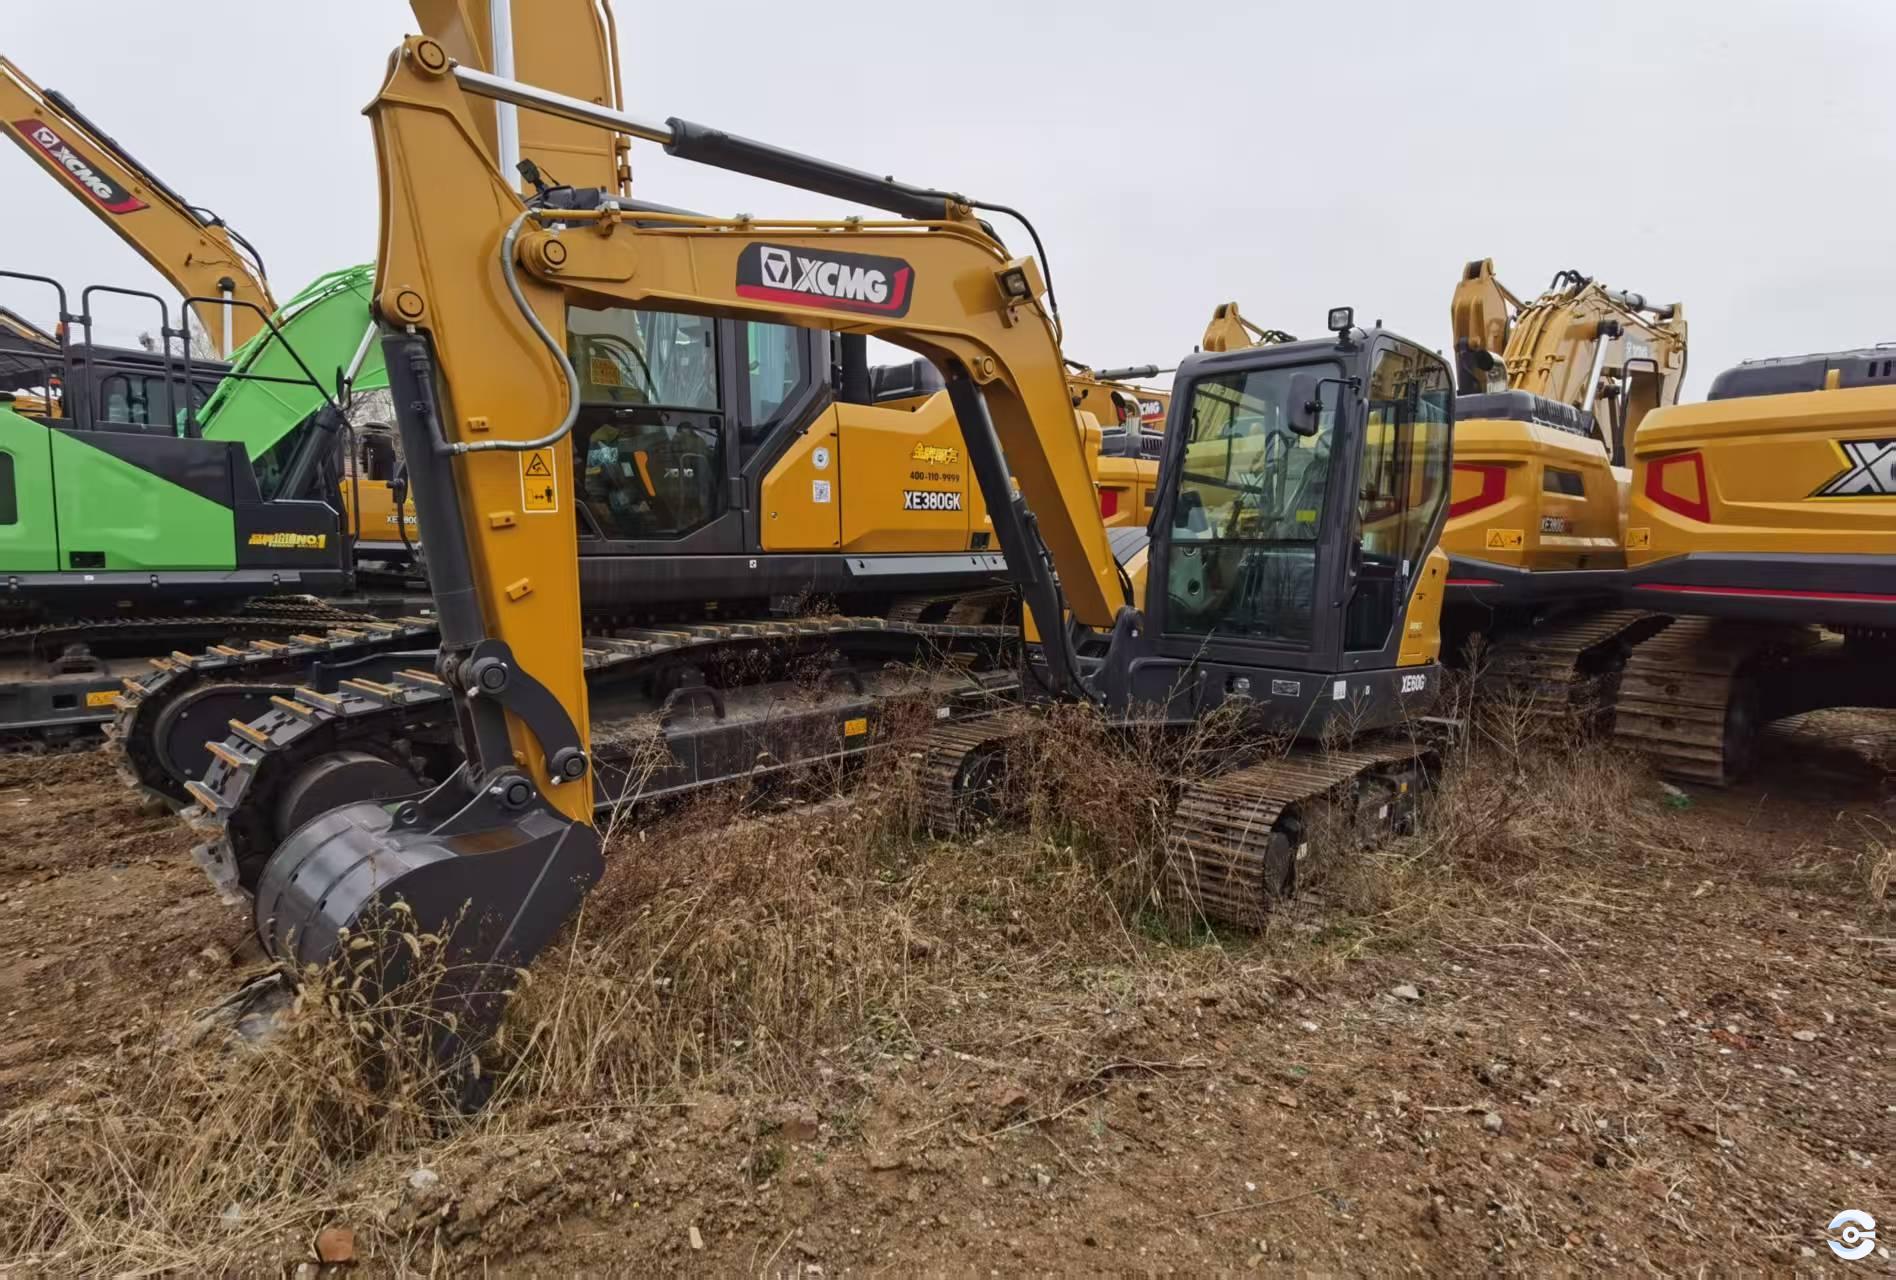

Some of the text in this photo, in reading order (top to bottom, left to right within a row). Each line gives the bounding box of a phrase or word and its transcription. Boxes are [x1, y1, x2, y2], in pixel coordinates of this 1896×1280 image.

[48, 146, 112, 199] XCMG
[793, 257, 888, 303] XCMG
[1140, 401, 1161, 416] CMG
[910, 471, 960, 483] 400-110-9999
[903, 490, 961, 511] XE380GK
[1401, 673, 1425, 693] XE60G
